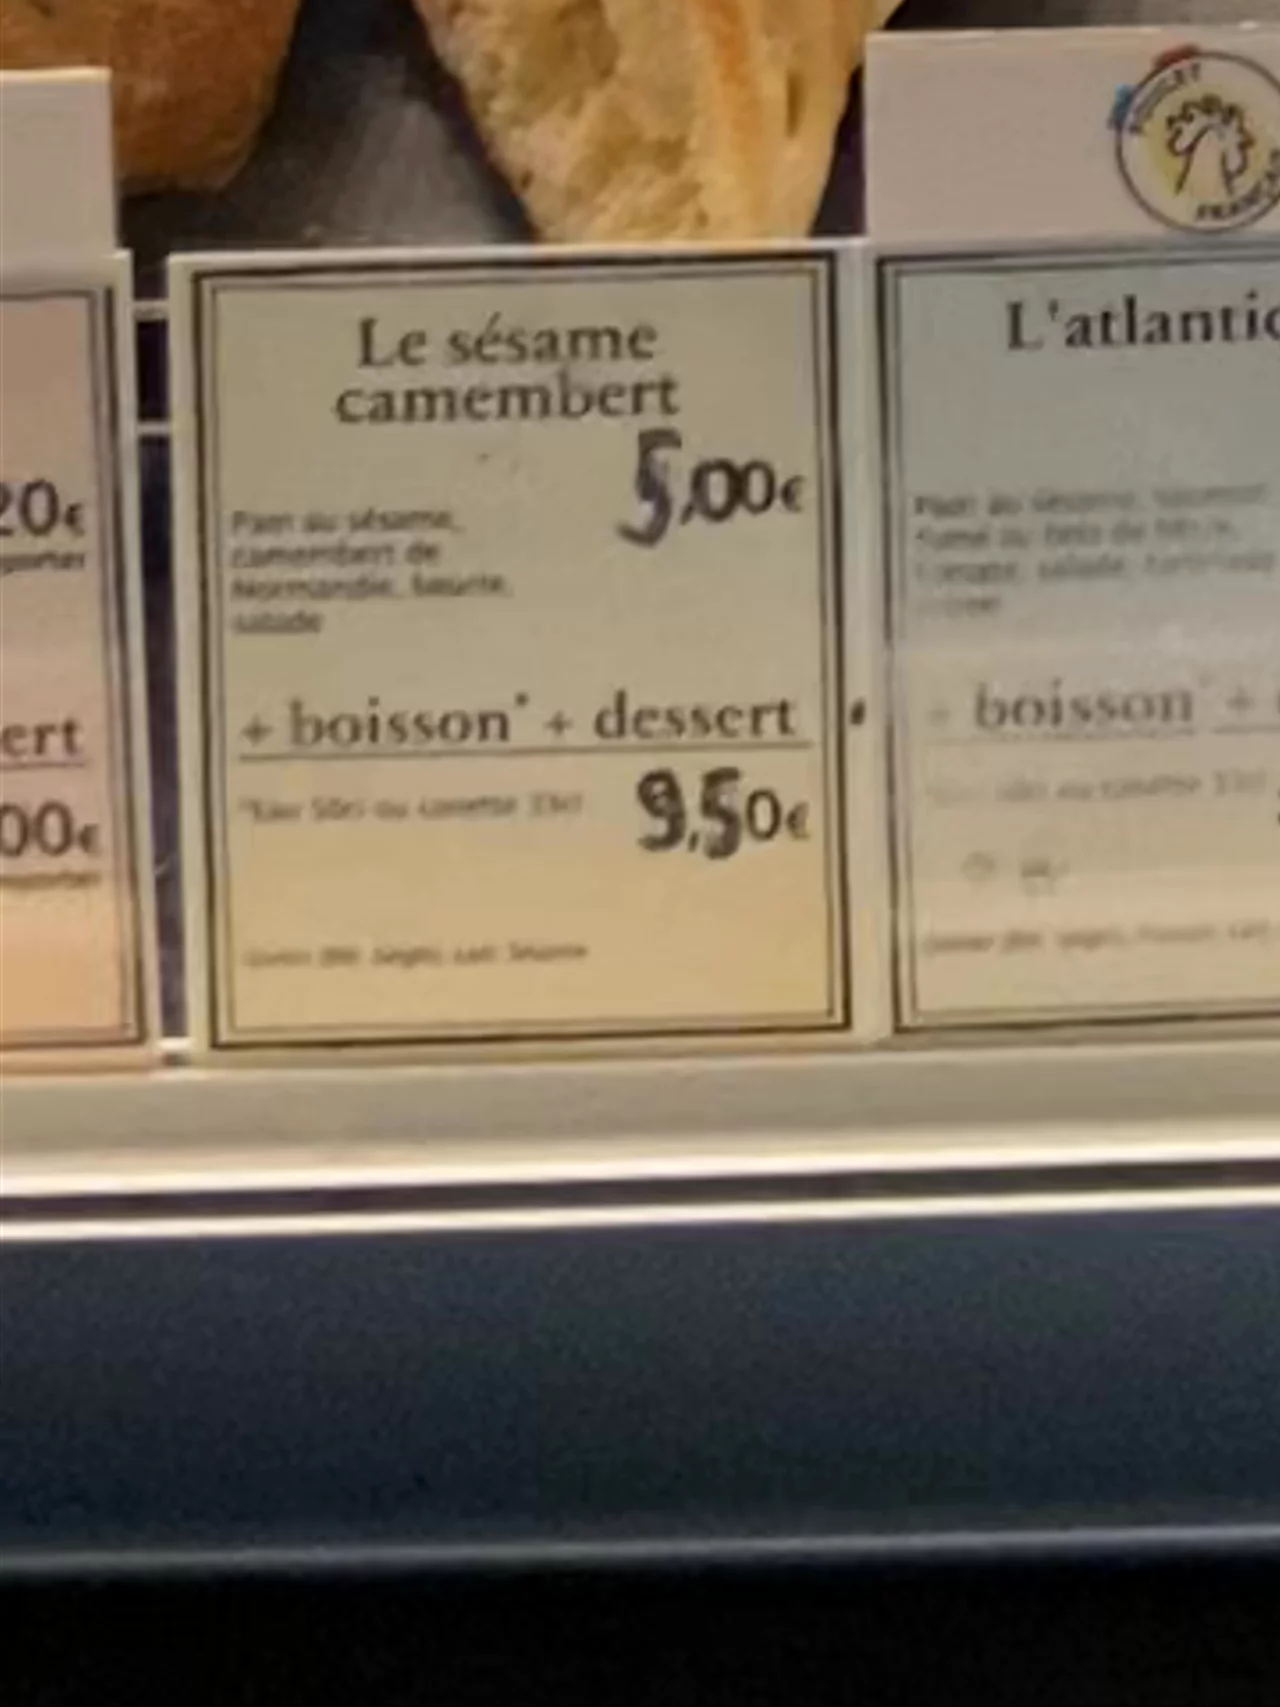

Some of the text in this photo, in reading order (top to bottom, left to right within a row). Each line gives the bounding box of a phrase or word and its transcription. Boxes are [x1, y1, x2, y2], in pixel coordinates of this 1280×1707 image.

[357, 311, 659, 368] Le sésame
[333, 371, 682, 426] camembert
[241, 717, 273, 746] +
[547, 711, 575, 740] +
[593, 689, 797, 740] dessert
[637, 764, 810, 860] 9,50€
